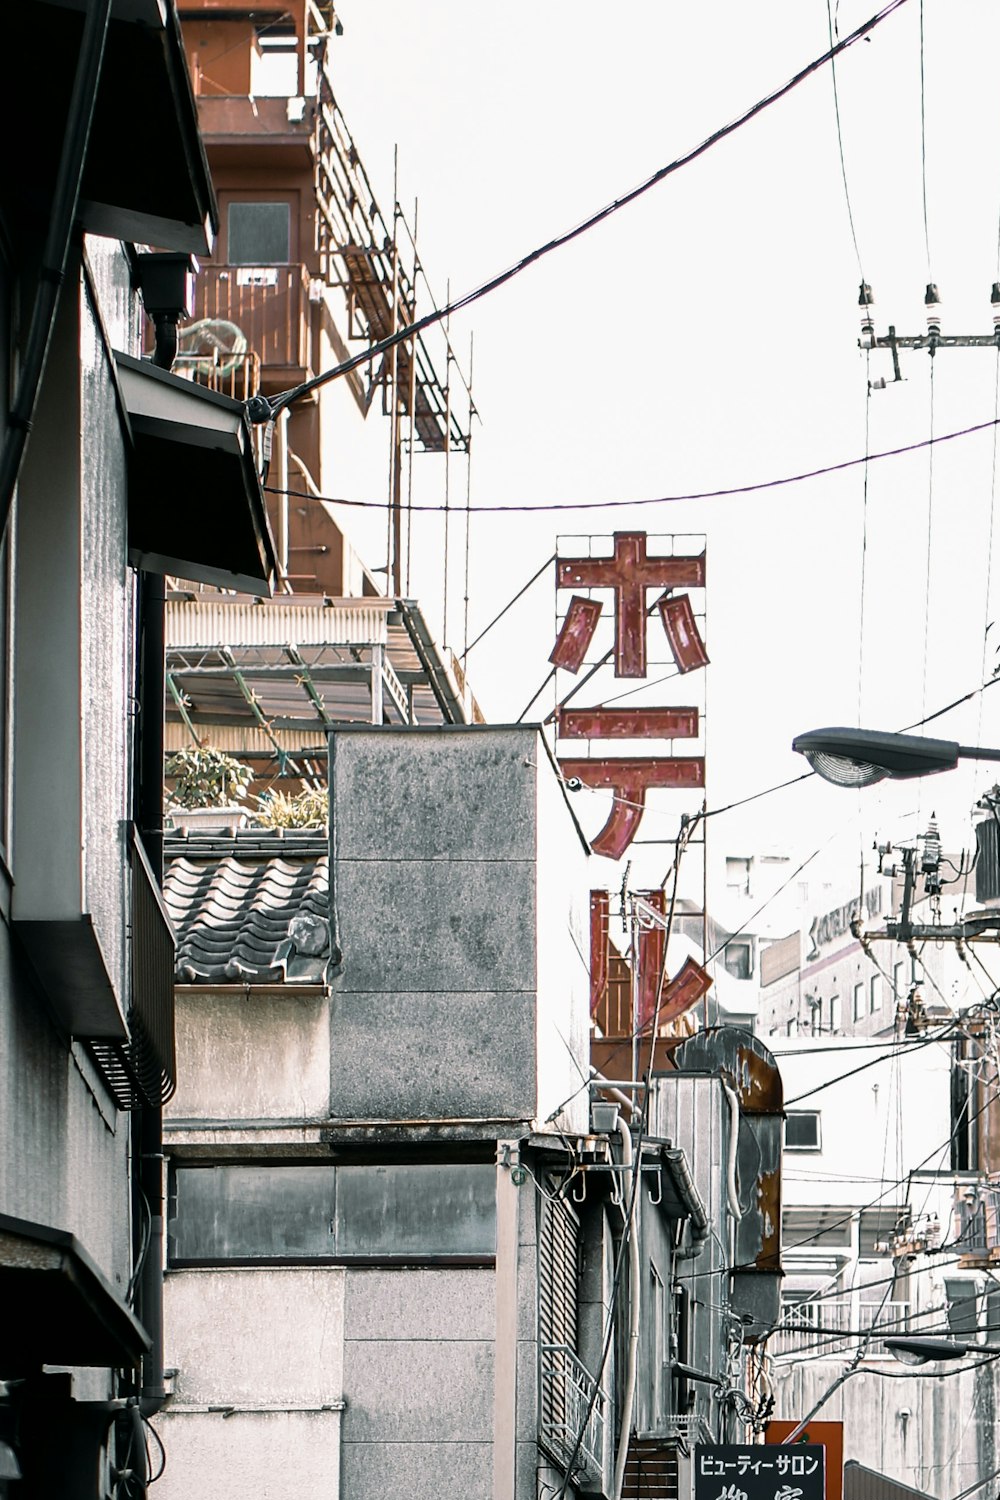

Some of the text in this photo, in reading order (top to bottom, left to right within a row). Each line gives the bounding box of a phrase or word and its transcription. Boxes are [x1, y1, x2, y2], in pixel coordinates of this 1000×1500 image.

[548, 531, 713, 1036] ホテル
[700, 1455, 819, 1476] ビューティーサロン
